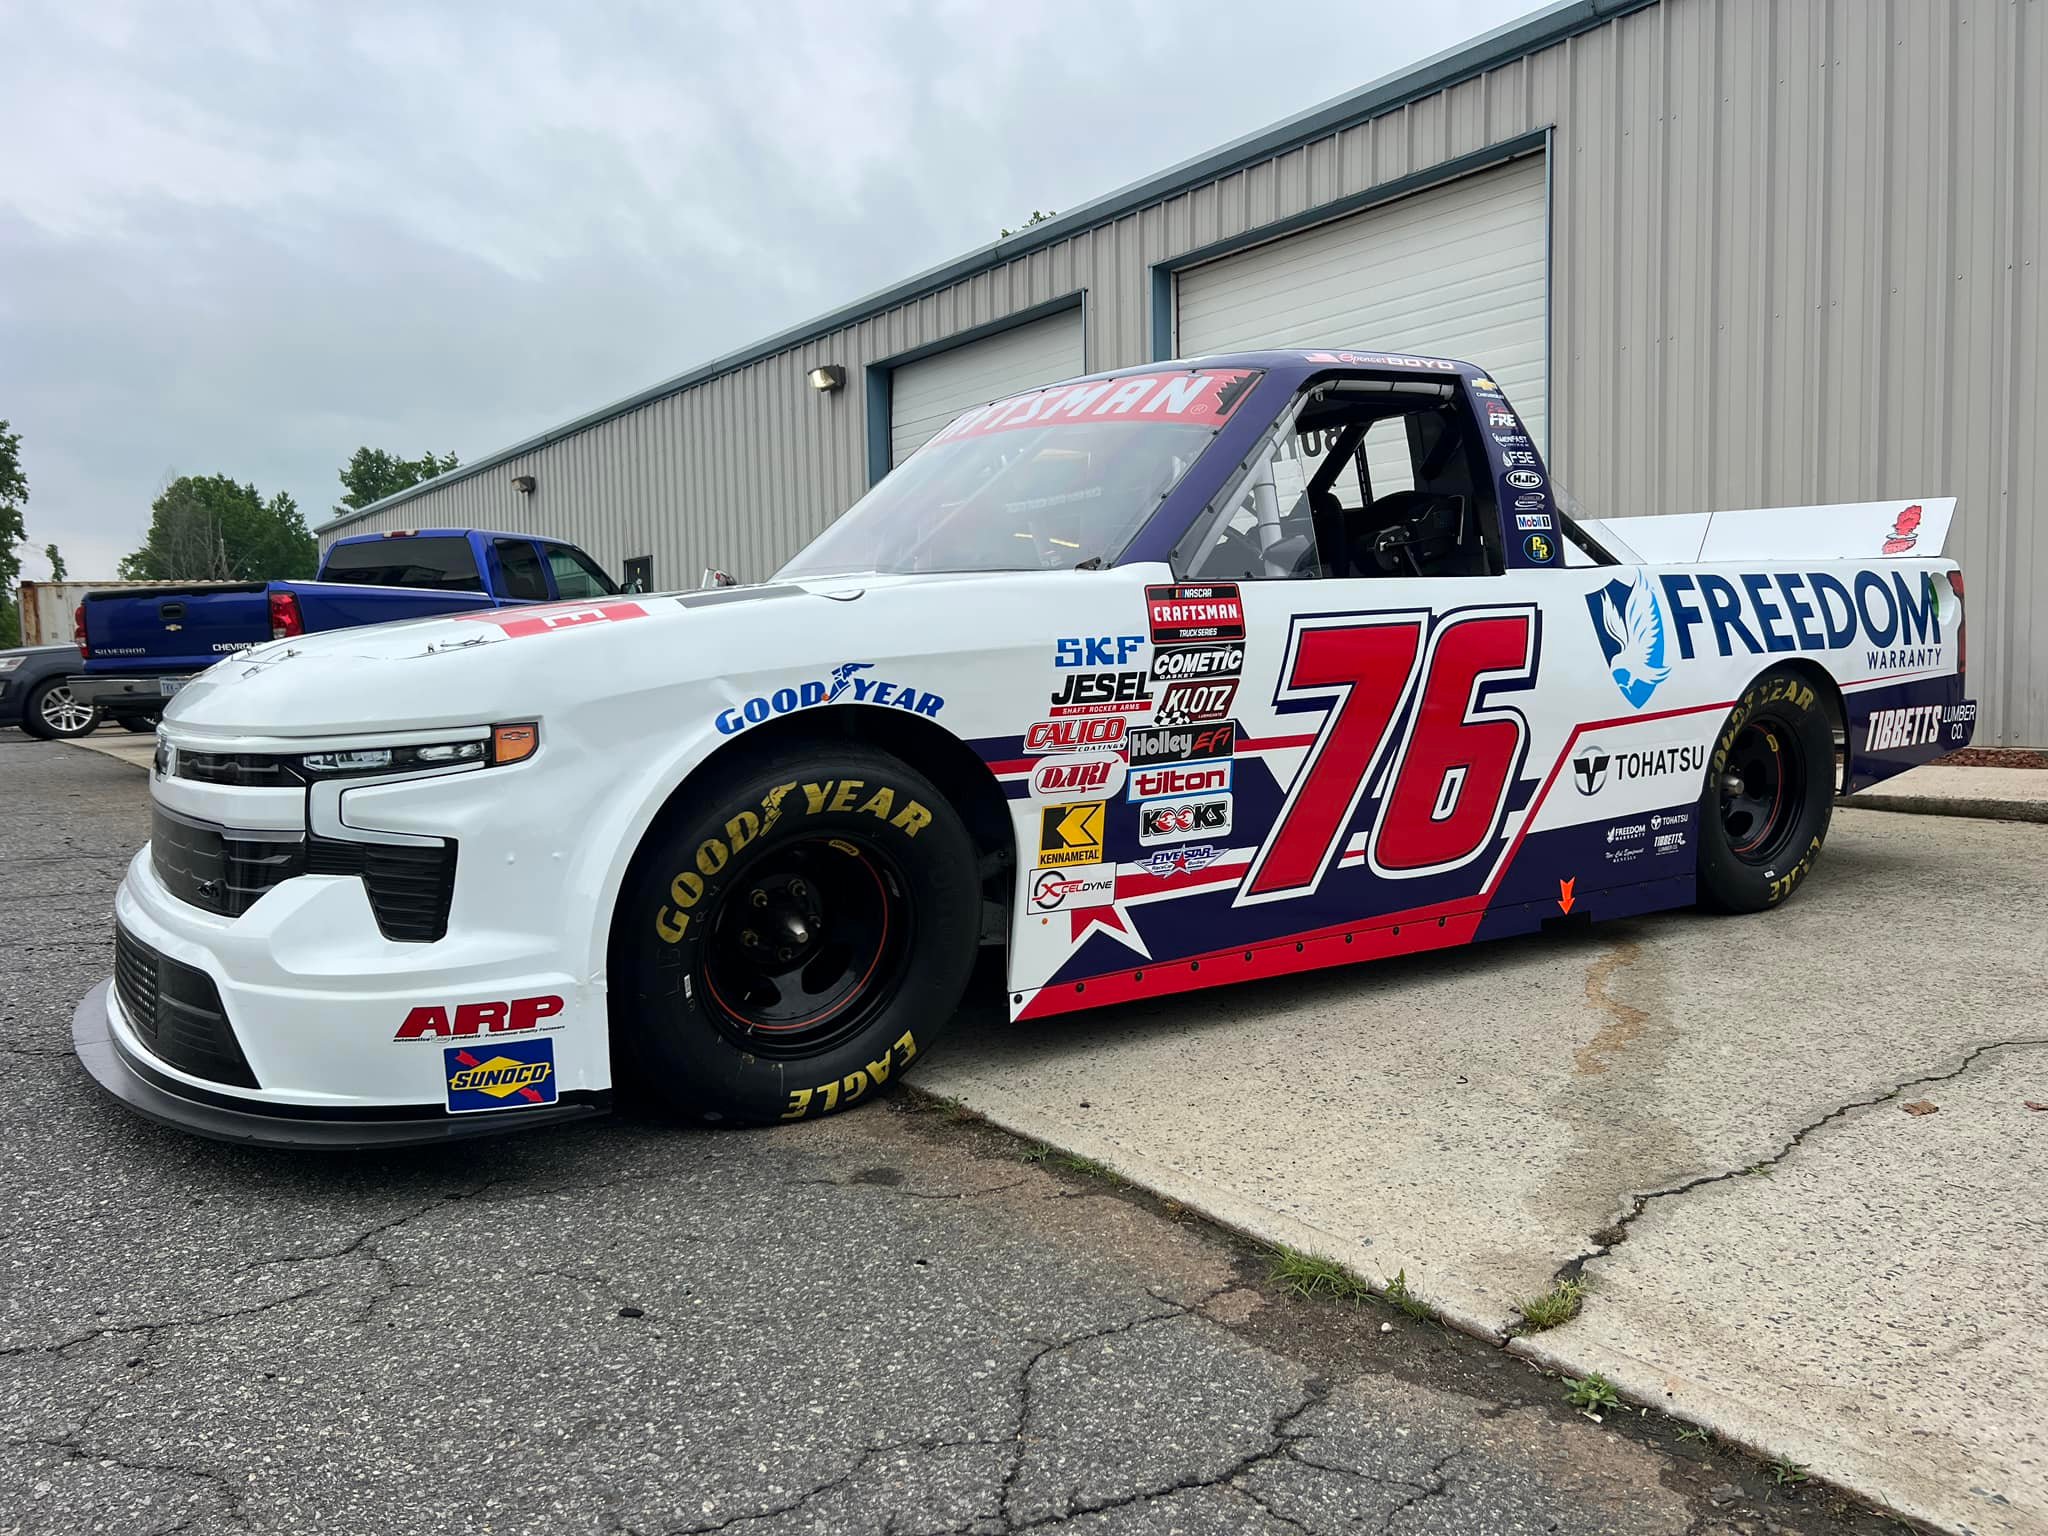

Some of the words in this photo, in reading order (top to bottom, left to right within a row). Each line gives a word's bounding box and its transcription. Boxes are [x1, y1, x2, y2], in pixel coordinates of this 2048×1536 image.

[1388, 357, 1454, 370] BOYD
[1489, 413, 1516, 427] FRE
[1508, 451, 1535, 463] FSE
[1513, 474, 1537, 484] HJC
[1519, 516, 1541, 528] Mobil
[1184, 588, 1213, 599] NASCAR
[1153, 603, 1238, 622] CRAFTSMAN
[1658, 570, 1942, 660] FREEDOM
[1179, 629, 1198, 638] TRUCK
[1197, 628, 1218, 637] SERIES
[1055, 635, 1144, 667] SKF
[1154, 649, 1243, 675] COMETIC
[1867, 648, 1942, 670] WARRANTY
[1051, 671, 1154, 706] JESEL
[1165, 685, 1233, 714] KLOTZ
[1062, 707, 1086, 715] SHAFT
[1089, 705, 1117, 713] ROCKER
[1120, 703, 1140, 711] ARMS
[1026, 716, 1127, 750] CALICO
[1865, 705, 1942, 751] TIBBETTS
[1943, 704, 1976, 723] LUMBER
[1078, 743, 1124, 752] COATINGS
[1131, 731, 1192, 759] Holley
[1232, 602, 1543, 908] 76
[1615, 745, 1704, 780] TOHATSU
[1041, 761, 1113, 790] DART
[1135, 769, 1225, 796] tilton
[1141, 801, 1228, 837] KOOKS
[1615, 824, 1645, 836] FREEDOM
[1663, 814, 1688, 825] TOHATSU
[1040, 850, 1099, 865] KENNAMETAL
[1152, 851, 1181, 866] FIVE
[1183, 847, 1213, 859] STAR
[1032, 880, 1113, 901] XCELDYNE
[394, 995, 564, 1038] ARP
[454, 1064, 547, 1089] SUNOCO
[780, 1030, 918, 1120] EAGLE
